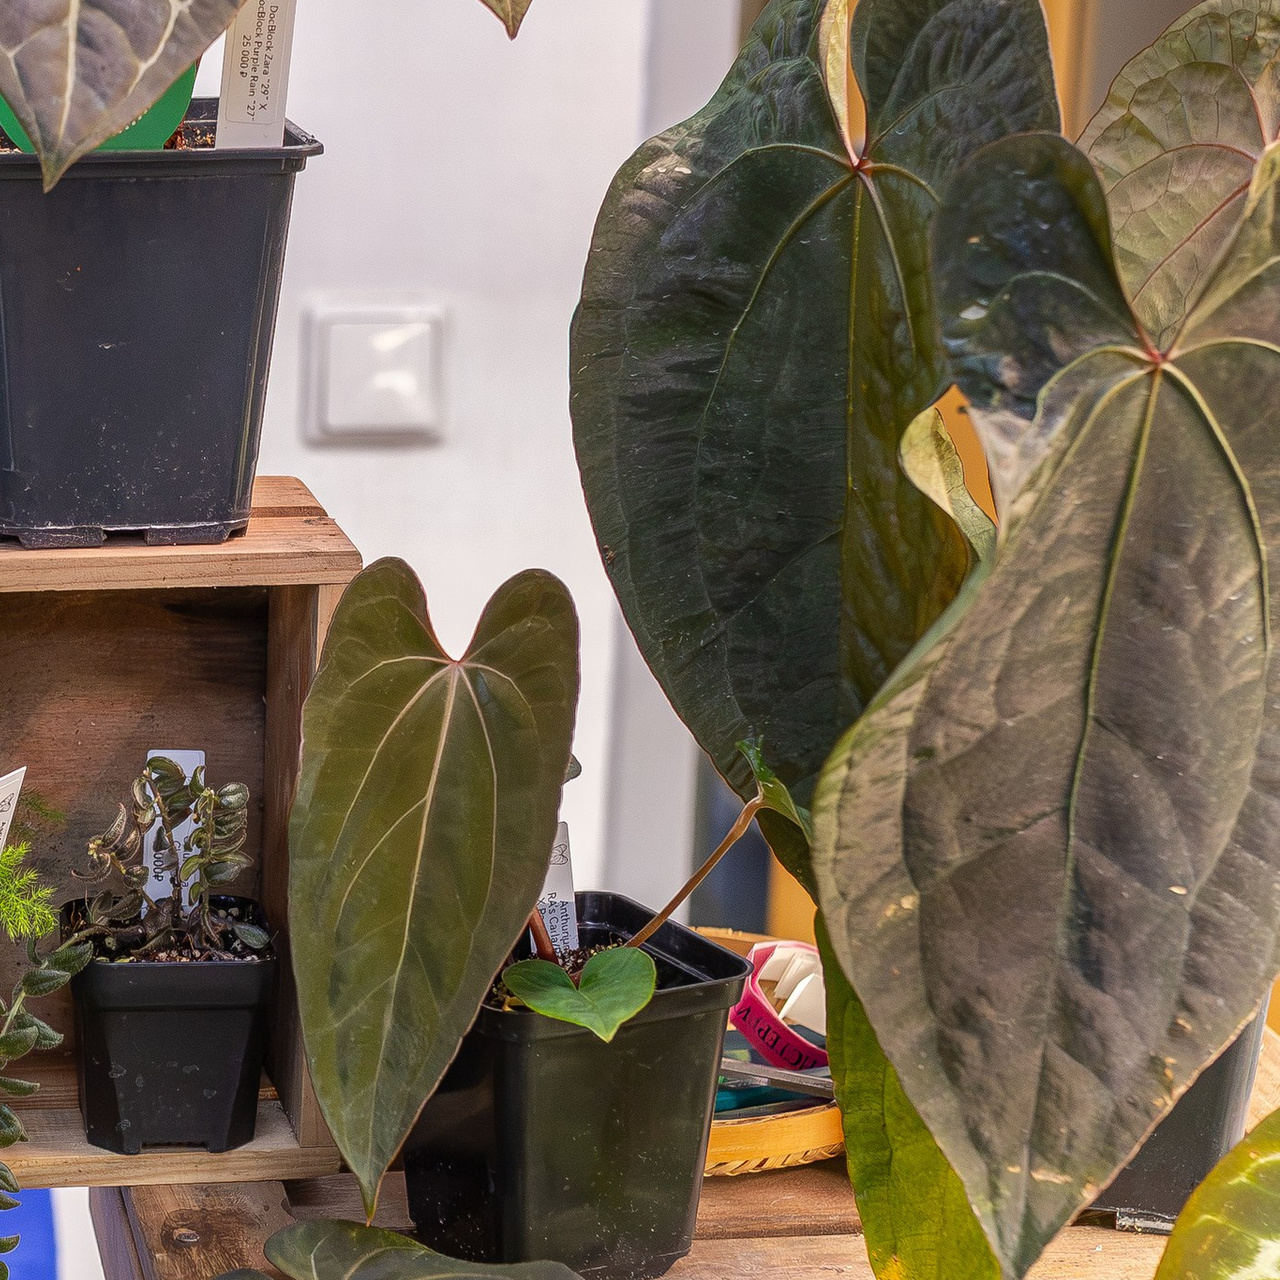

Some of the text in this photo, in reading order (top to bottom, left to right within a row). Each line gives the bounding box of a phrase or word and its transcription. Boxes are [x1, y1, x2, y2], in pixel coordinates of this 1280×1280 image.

[265, 5, 279, 52] DocBlock
[242, 34, 251, 47] 25
[240, 50, 250, 69] 000
[250, 41, 263, 73] Purple
[262, 54, 273, 75] Zara
[248, 75, 259, 97] Rain
